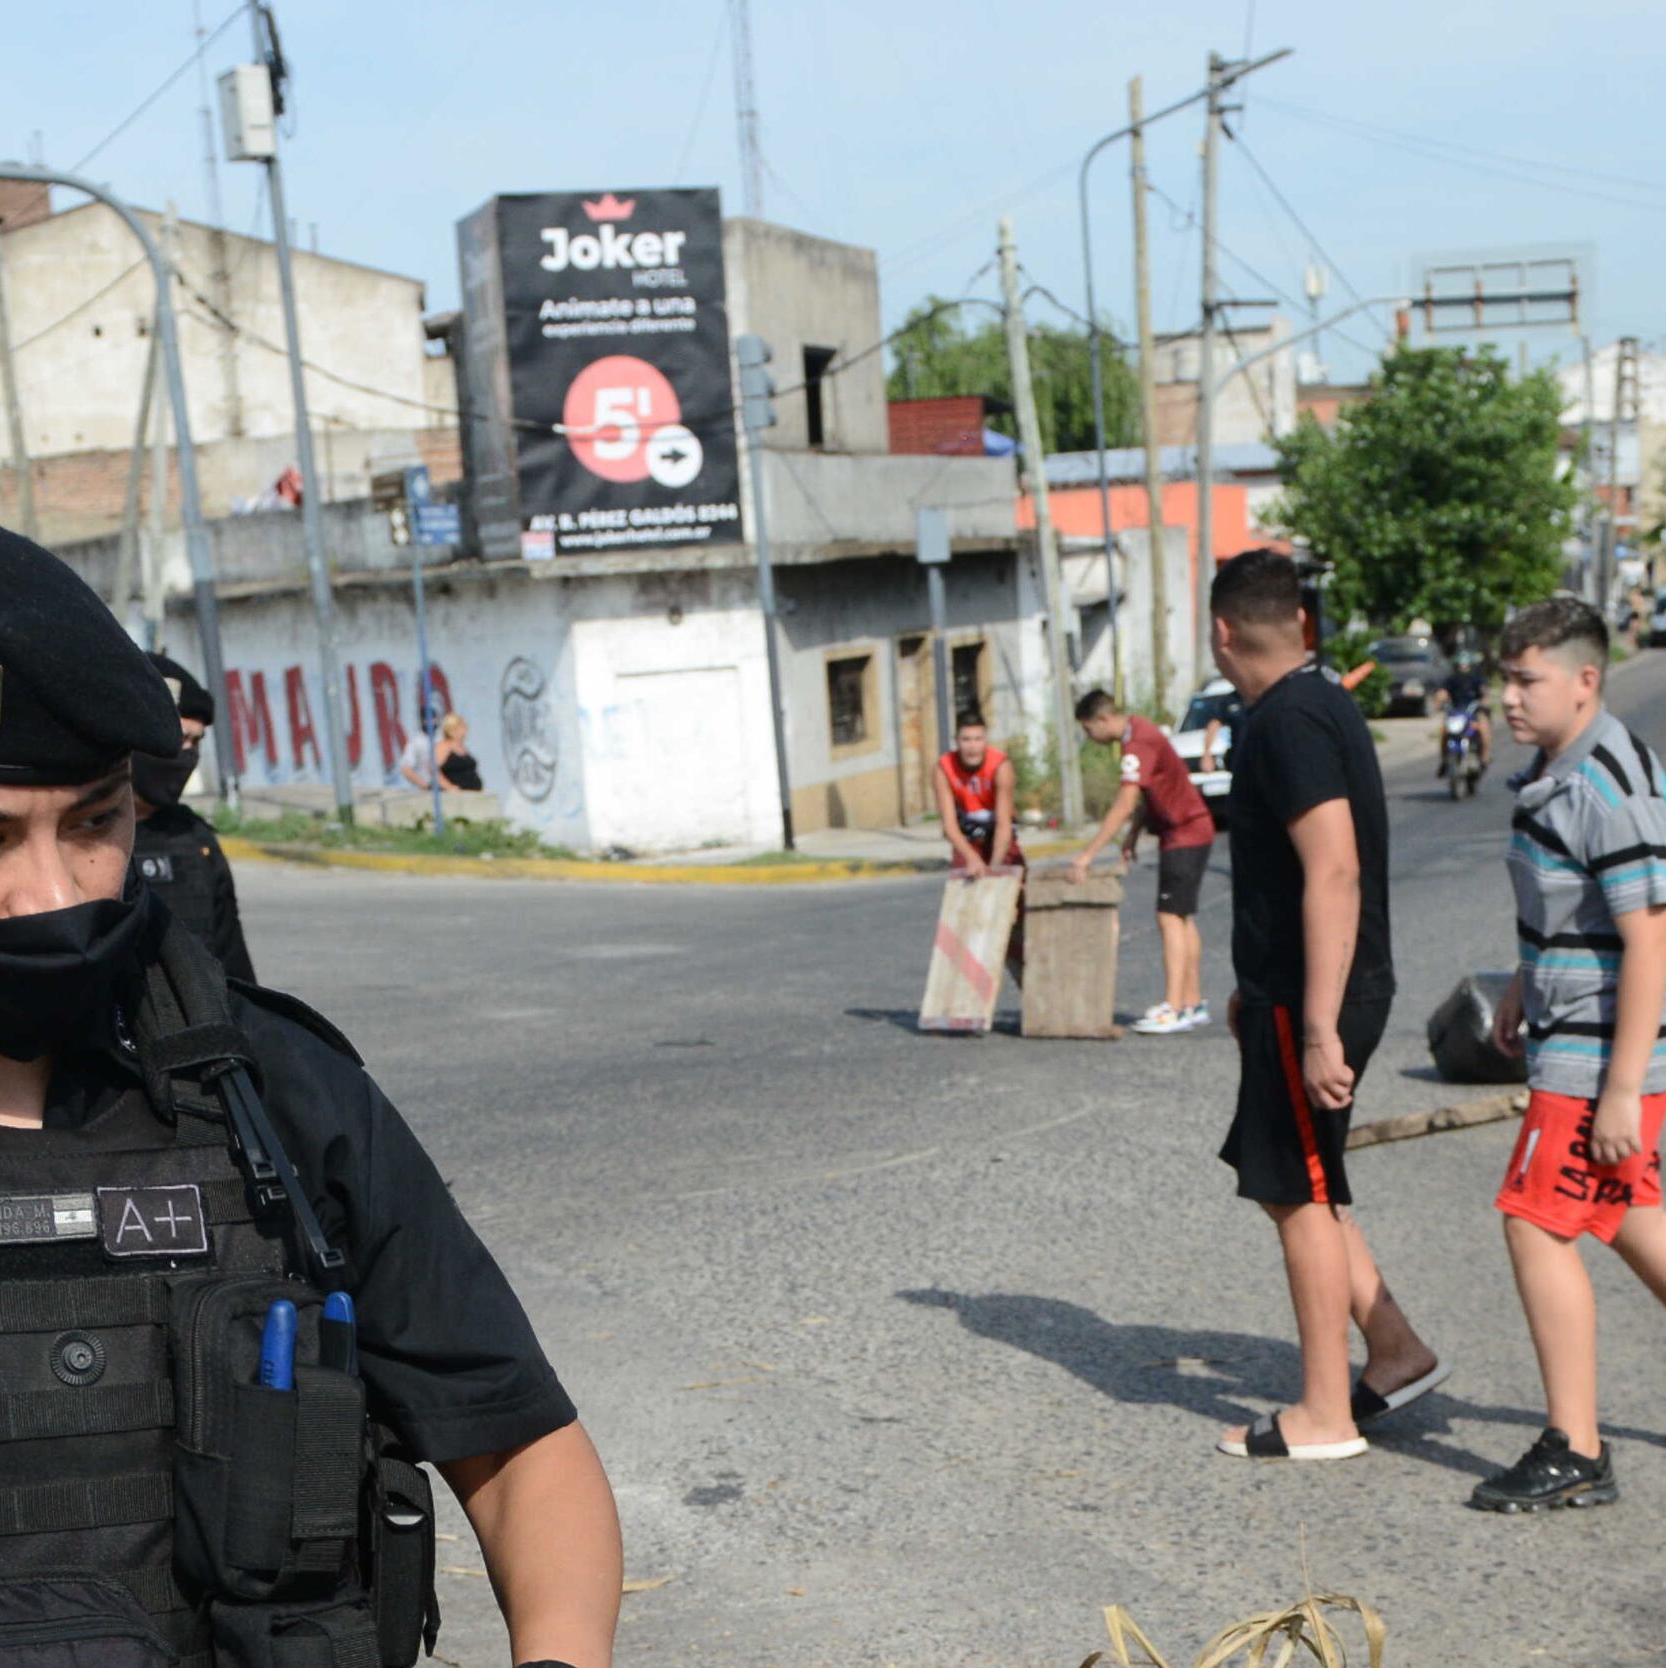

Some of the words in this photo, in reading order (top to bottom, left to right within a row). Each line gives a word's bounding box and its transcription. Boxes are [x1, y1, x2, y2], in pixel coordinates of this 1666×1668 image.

[539, 223, 687, 273] Joker
[539, 297, 634, 321] Animate
[635, 298, 652, 316] a
[653, 296, 697, 316] una
[116, 1197, 193, 1245] A+
